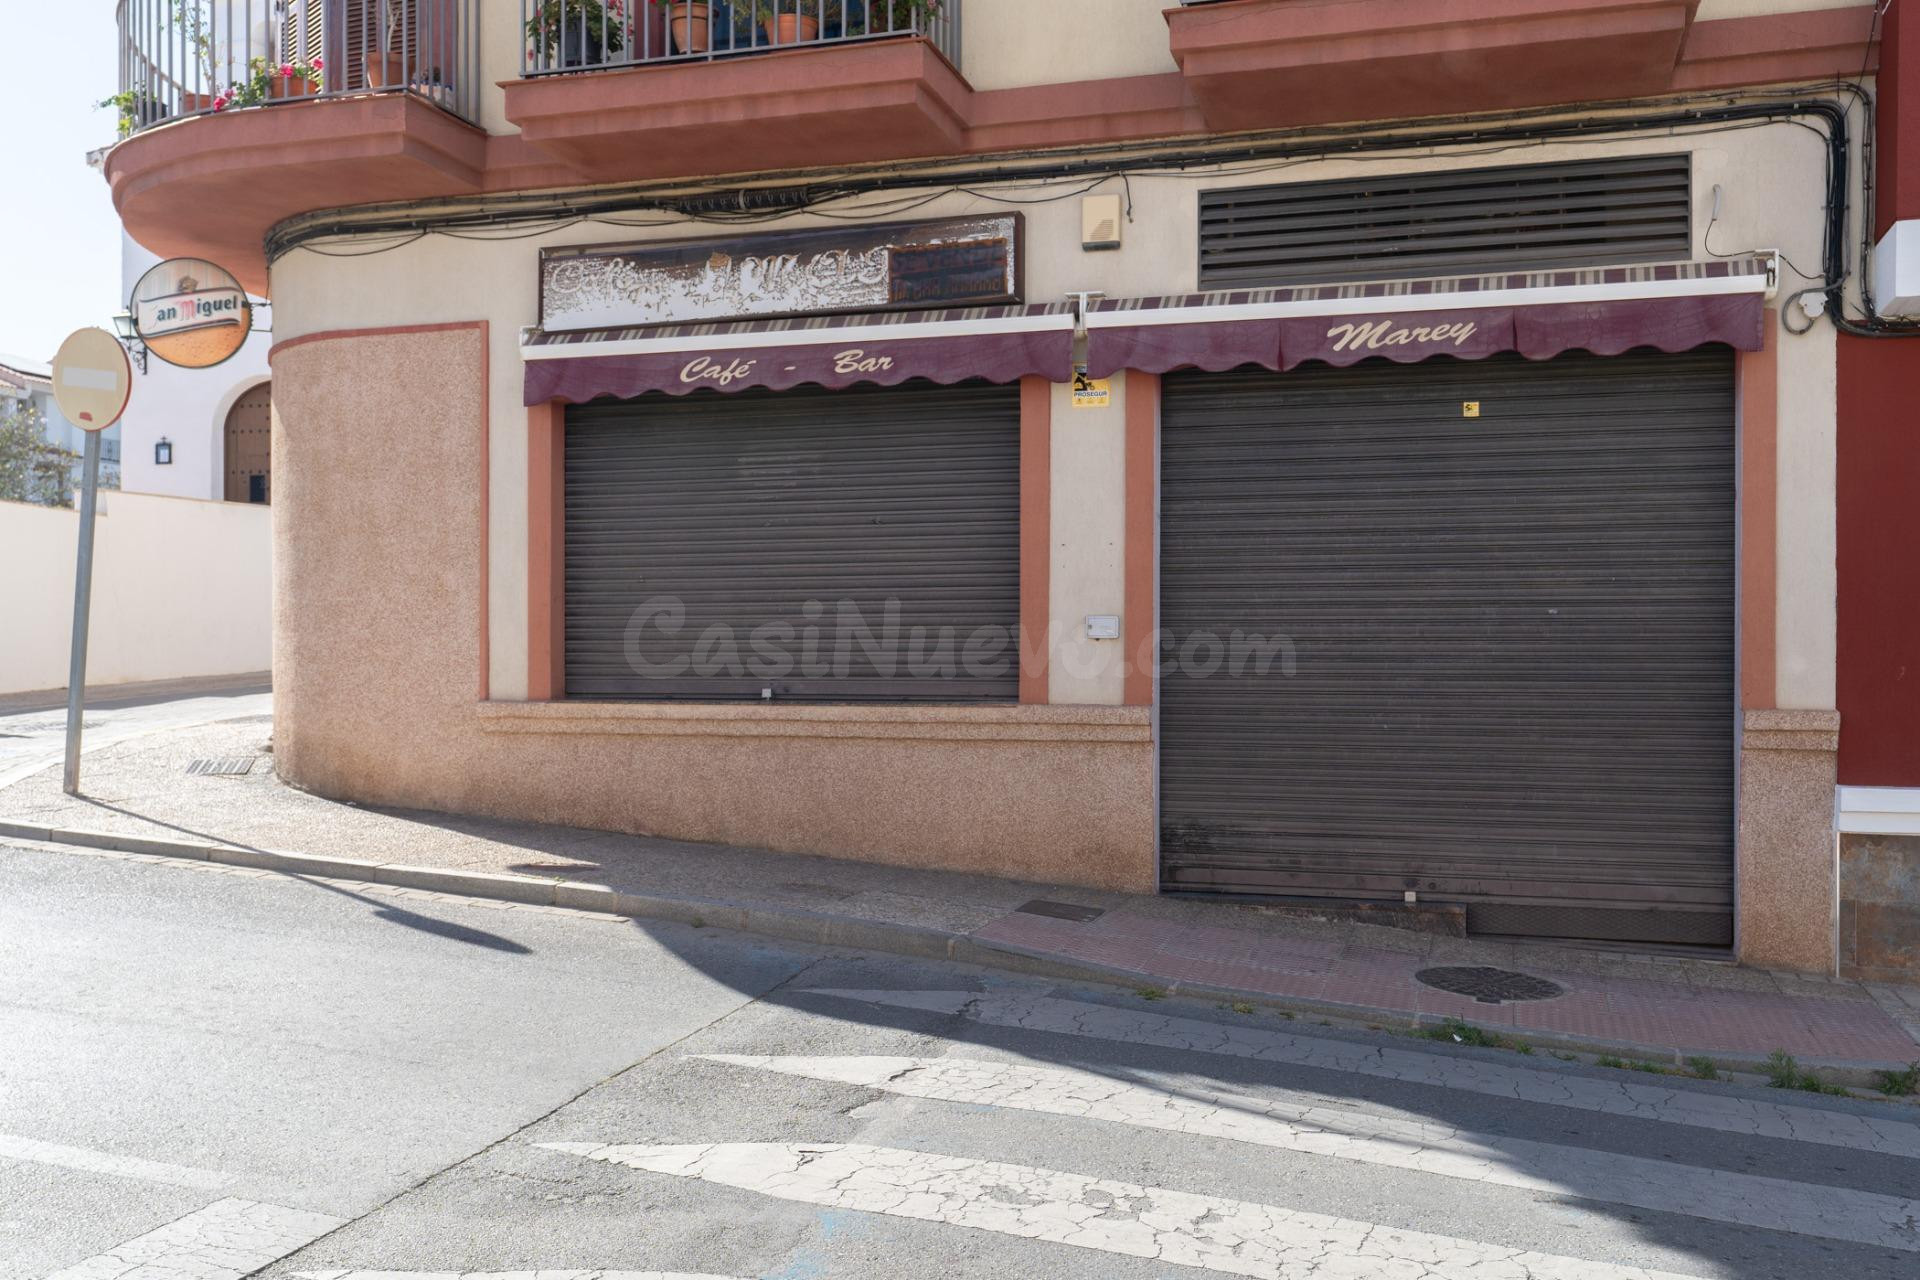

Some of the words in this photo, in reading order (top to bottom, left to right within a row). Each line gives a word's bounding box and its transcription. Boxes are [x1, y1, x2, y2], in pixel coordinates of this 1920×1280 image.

[178, 296, 238, 320] Miguel
[1327, 320, 1477, 351] Marey
[680, 356, 756, 385] Café
[833, 349, 894, 373] Bar
